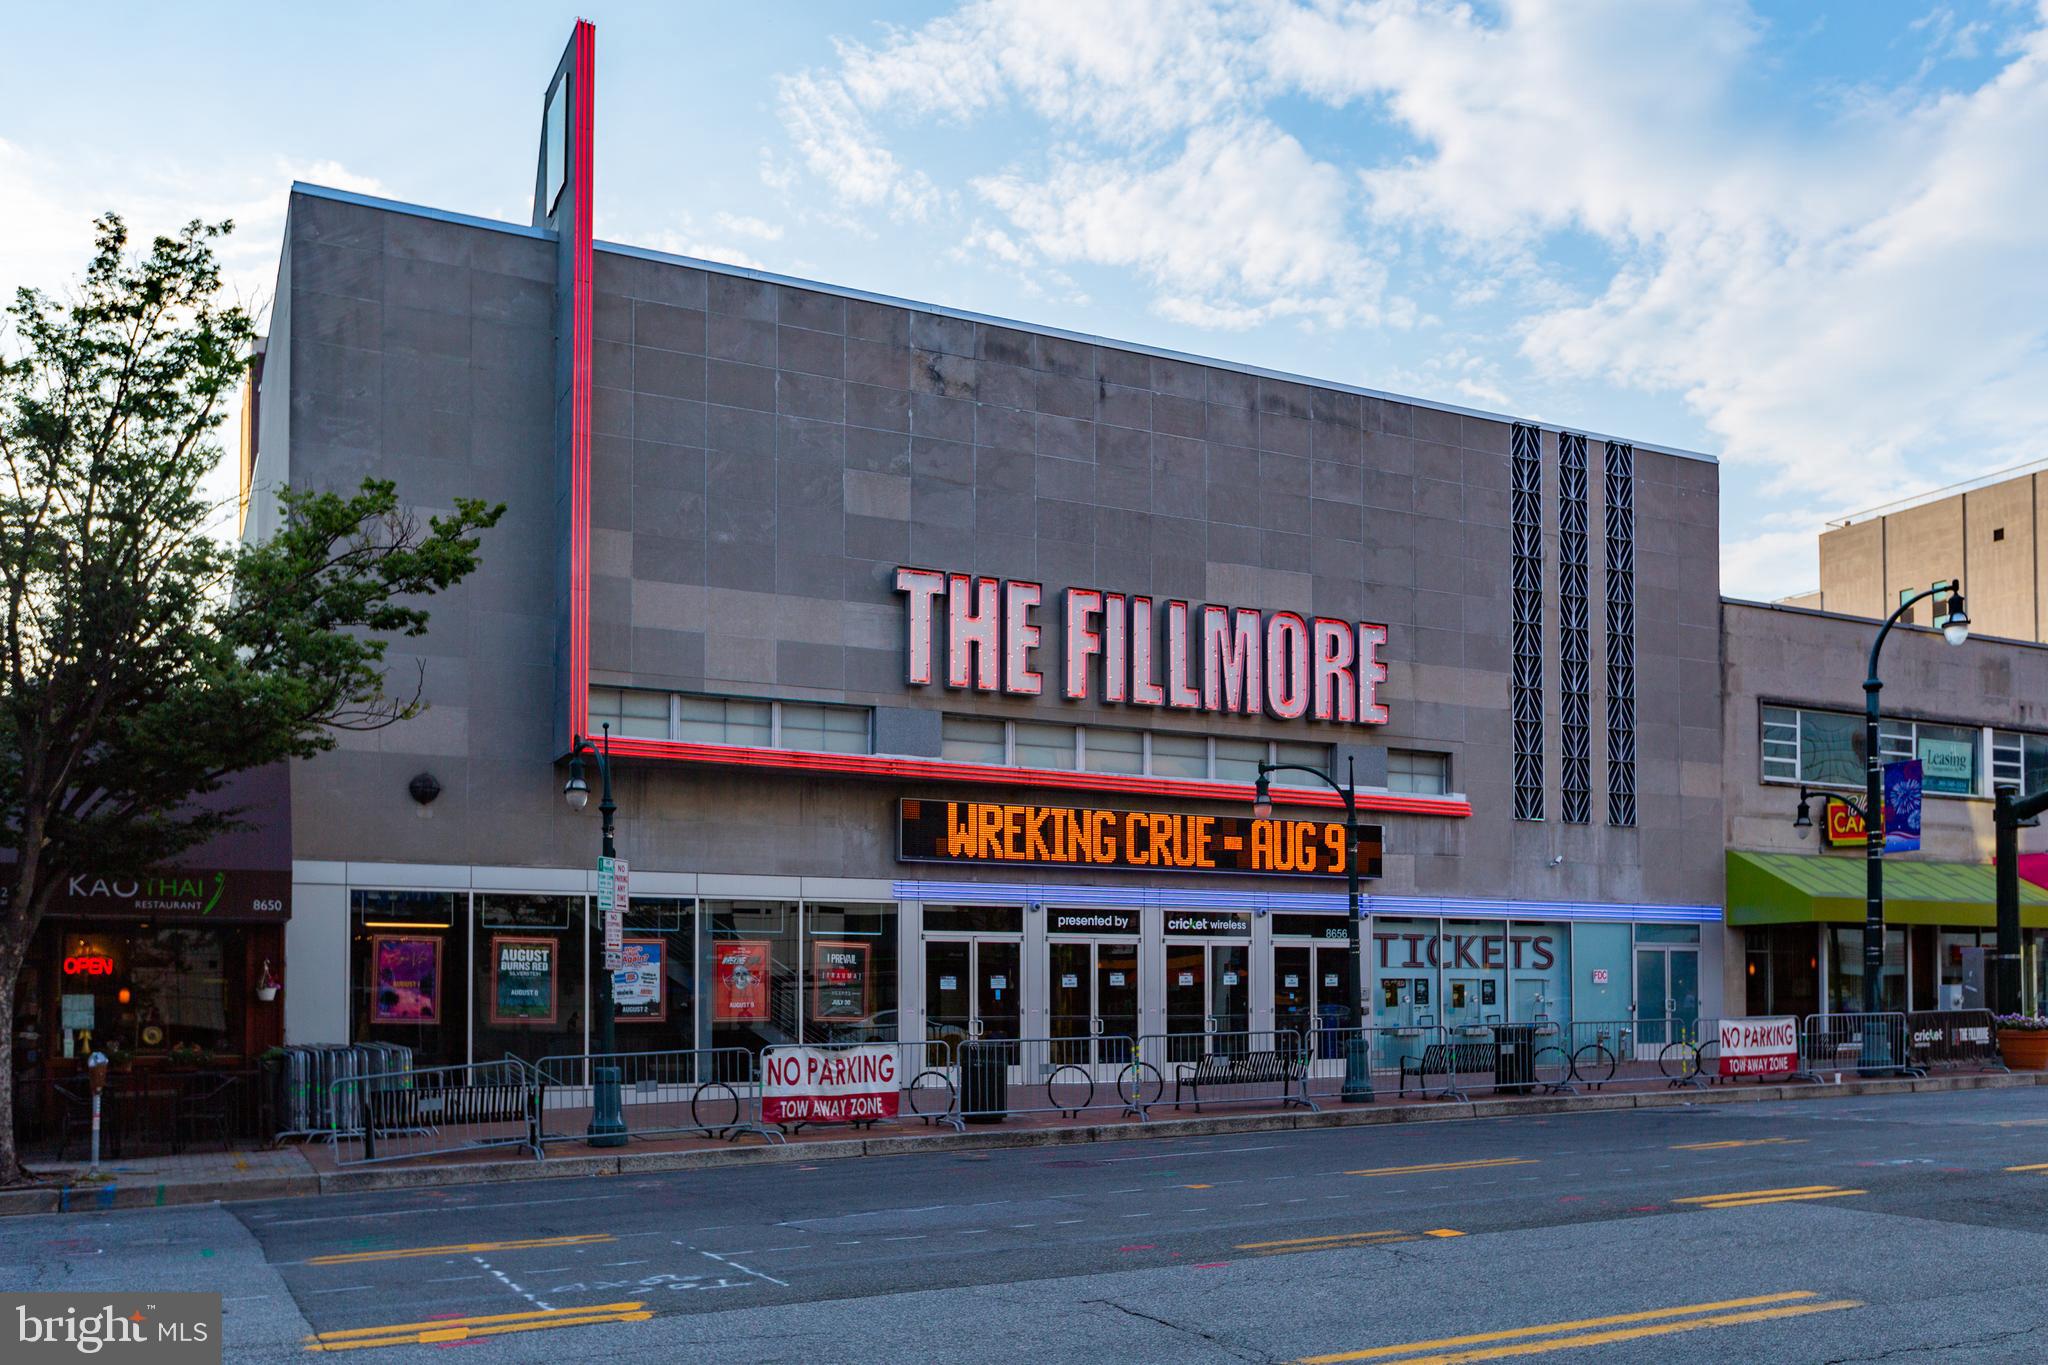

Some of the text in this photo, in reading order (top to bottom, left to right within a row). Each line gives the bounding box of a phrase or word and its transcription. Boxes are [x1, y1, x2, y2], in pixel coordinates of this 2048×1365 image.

[892, 566, 1390, 726] THE FILLMORE
[1927, 749, 1967, 771] Leasing
[947, 802, 1118, 864] WREKING
[1126, 812, 1215, 868] CRUE
[1251, 819, 1317, 872] AUG
[1324, 823, 1346, 873] 9
[617, 864, 625, 873] NO
[145, 879, 203, 897] THAI
[135, 900, 202, 911] RESTAURANT
[253, 899, 282, 911] 8650
[1058, 914, 1128, 929] presented by
[1168, 918, 1247, 930] cricket wireless
[1326, 928, 1347, 939] 8656
[501, 949, 550, 962] AUGUST
[831, 953, 857, 964] PREVAIL
[1373, 933, 1555, 970] TICKETS
[63, 956, 113, 975] OPEN
[501, 961, 548, 972] BURNS RED
[1593, 970, 1607, 981] FDC
[729, 1001, 749, 1009] AUGUST
[1721, 1024, 1793, 1048] NO PARKING
[1914, 1028, 1943, 1042] cricket
[767, 1054, 895, 1086] NO PARKING
[1729, 1056, 1788, 1073] TOW AWAY ZONE
[780, 1097, 884, 1119] TOW AWAY ZONE
